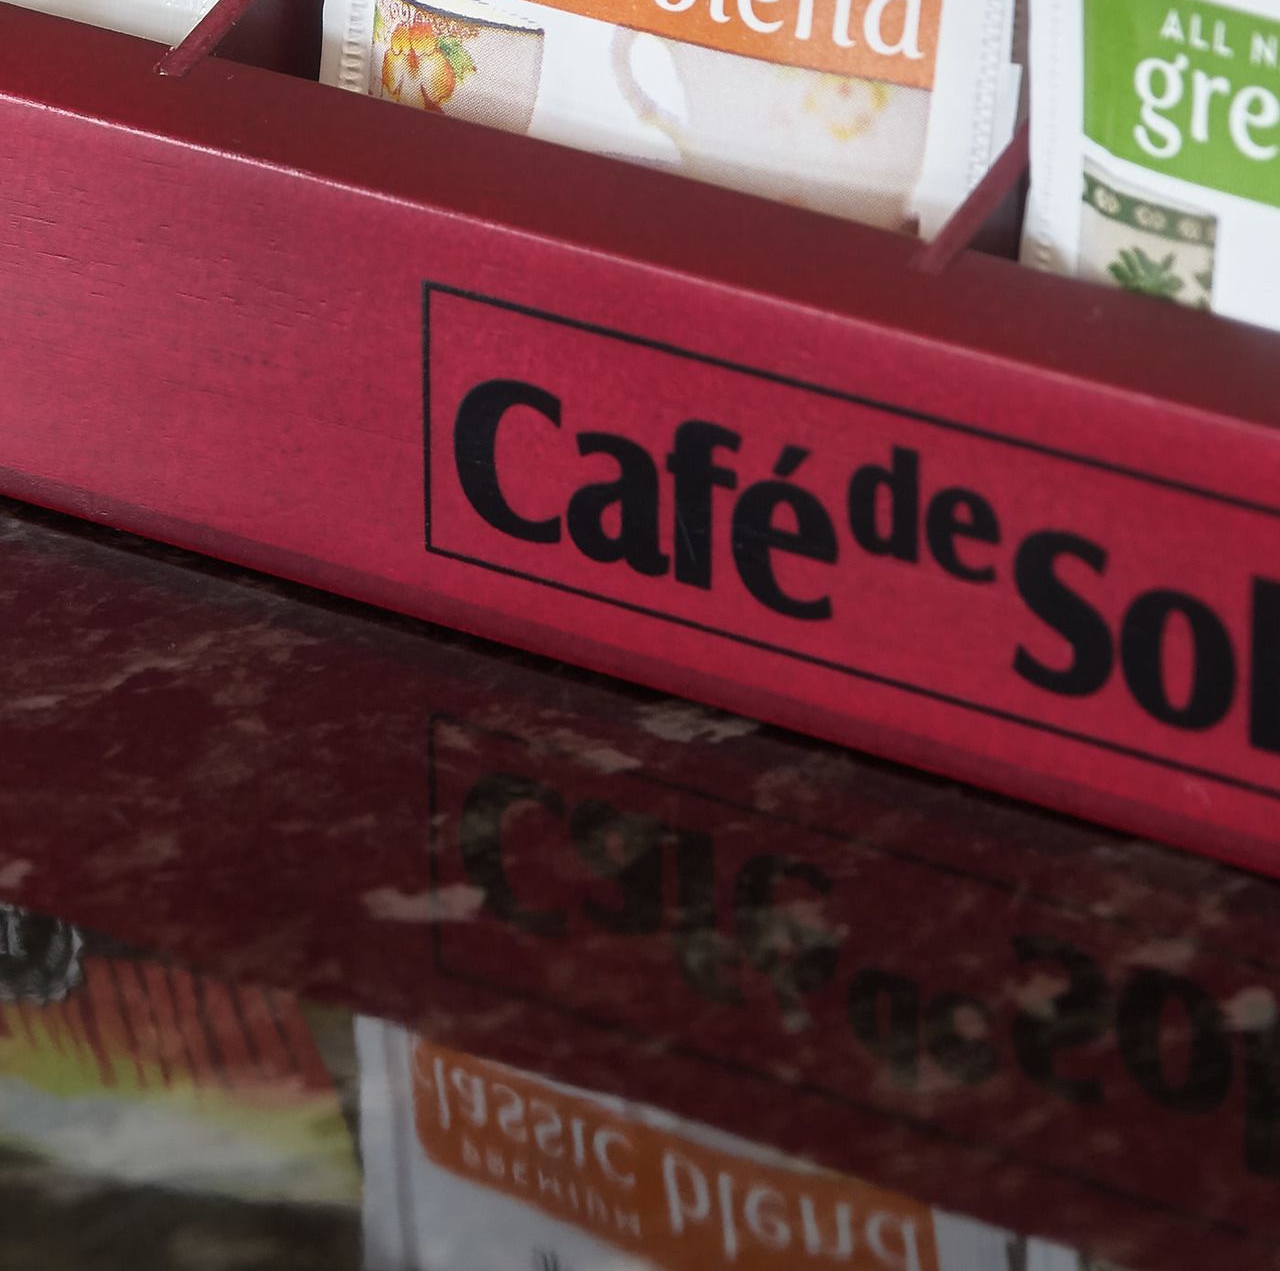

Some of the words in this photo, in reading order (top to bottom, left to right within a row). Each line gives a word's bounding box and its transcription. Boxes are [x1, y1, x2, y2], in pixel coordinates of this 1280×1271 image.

[1160, 8, 1235, 58] ALL
[453, 378, 840, 622] Café
[848, 444, 1002, 586] de
